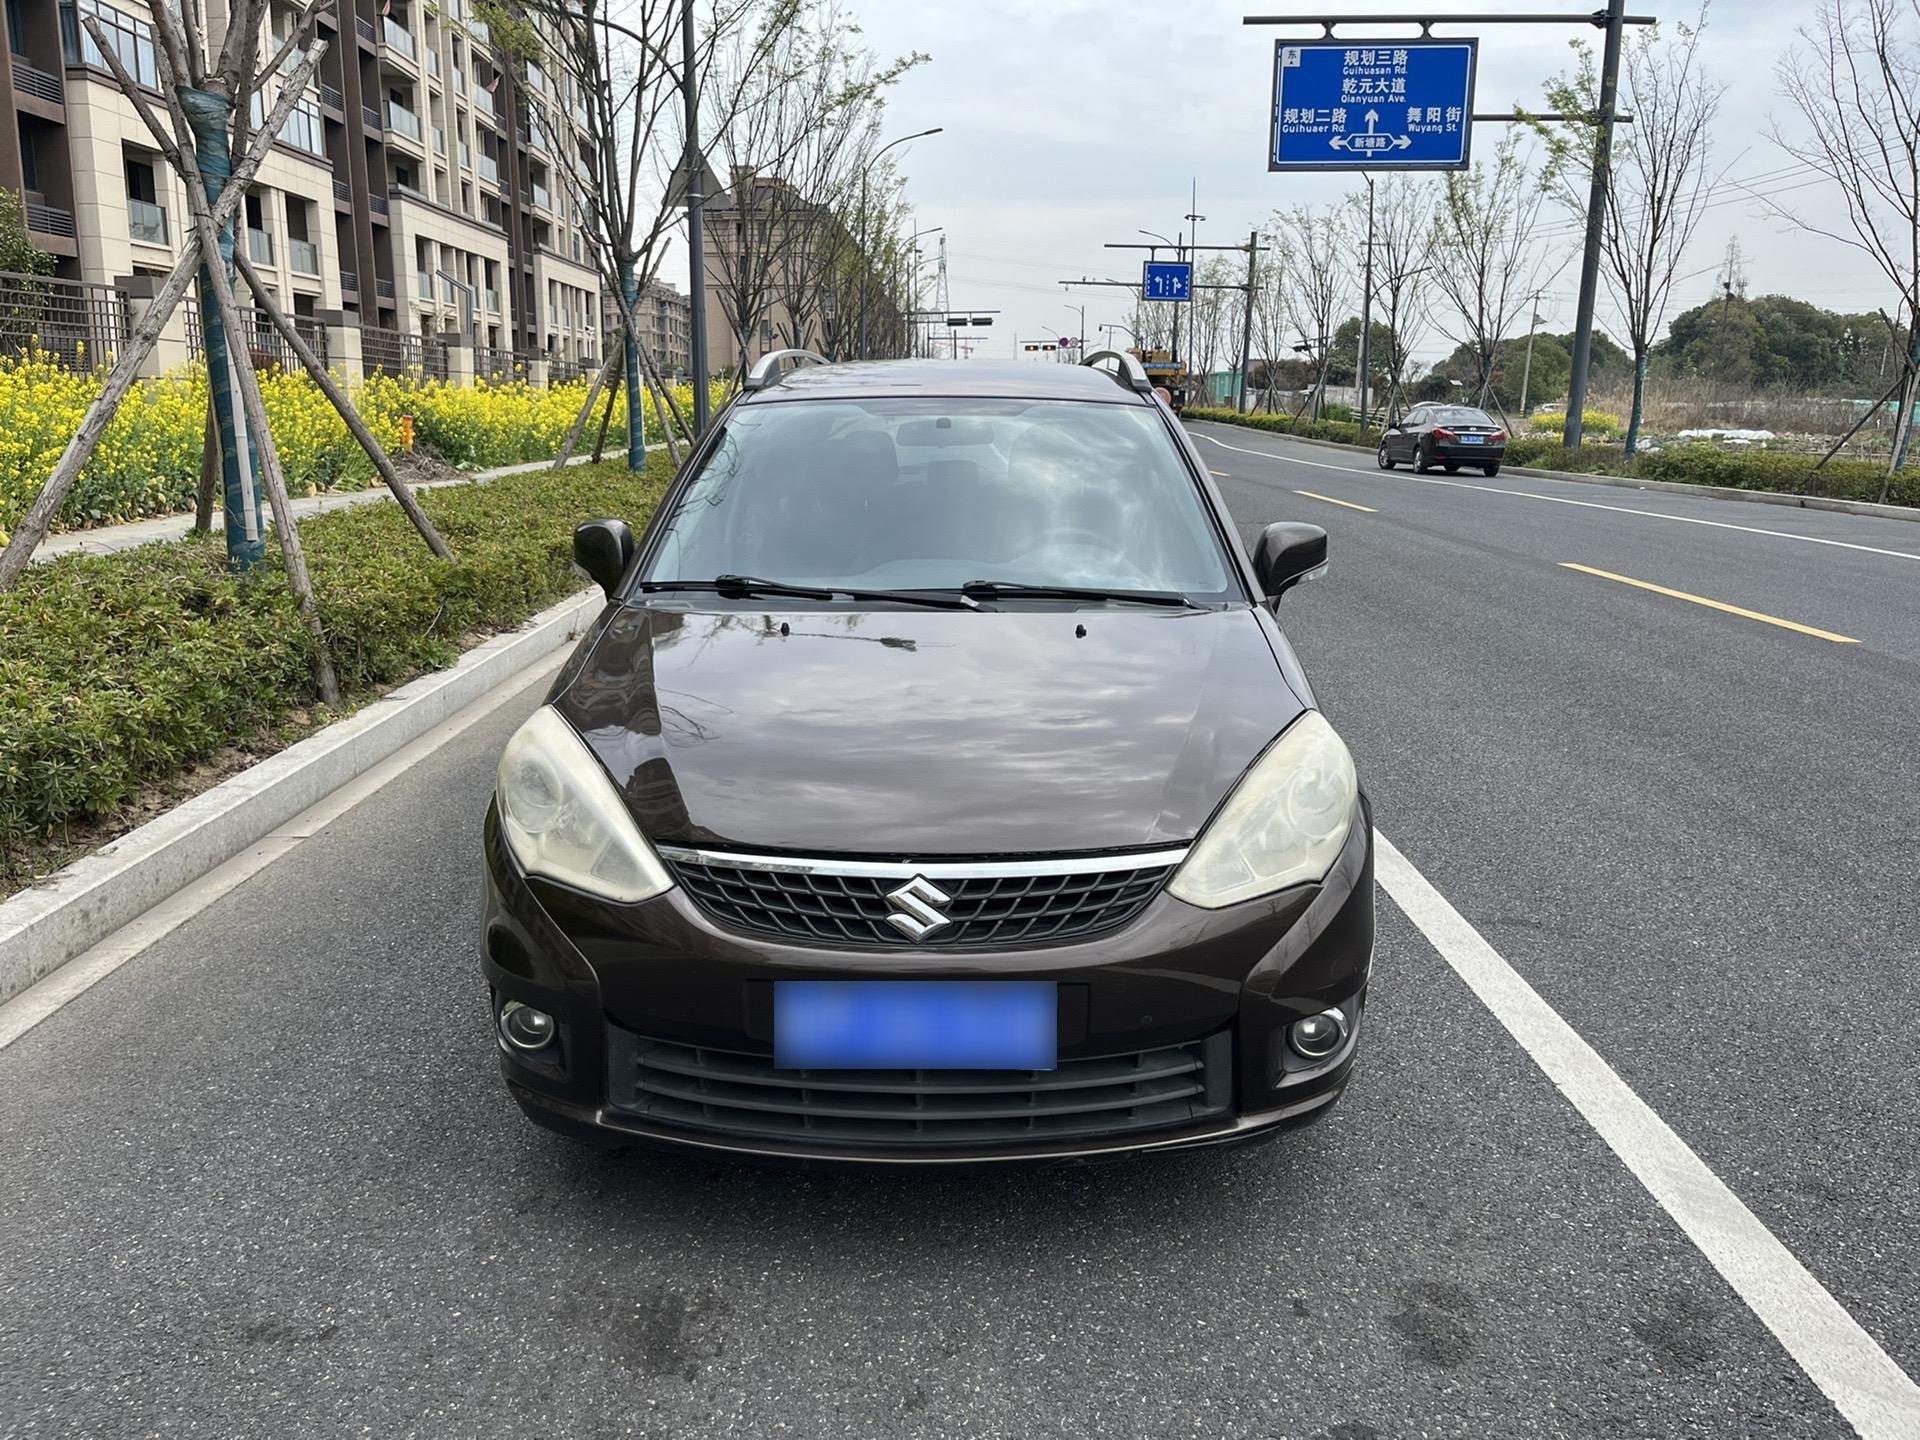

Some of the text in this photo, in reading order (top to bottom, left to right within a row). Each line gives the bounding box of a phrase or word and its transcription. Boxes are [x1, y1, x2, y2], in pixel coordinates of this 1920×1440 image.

[1344, 49, 1408, 66] 规划三路
[1342, 66, 1391, 75] Guihuasan
[1341, 78, 1406, 94] 乾元大道
[1341, 94, 1385, 105] Qianyuan
[1283, 108, 1348, 124] 规划二路
[1406, 107, 1461, 123] 舞阳街
[1282, 124, 1329, 133] Guihuaer
[1407, 124, 1443, 135] Wuyang
